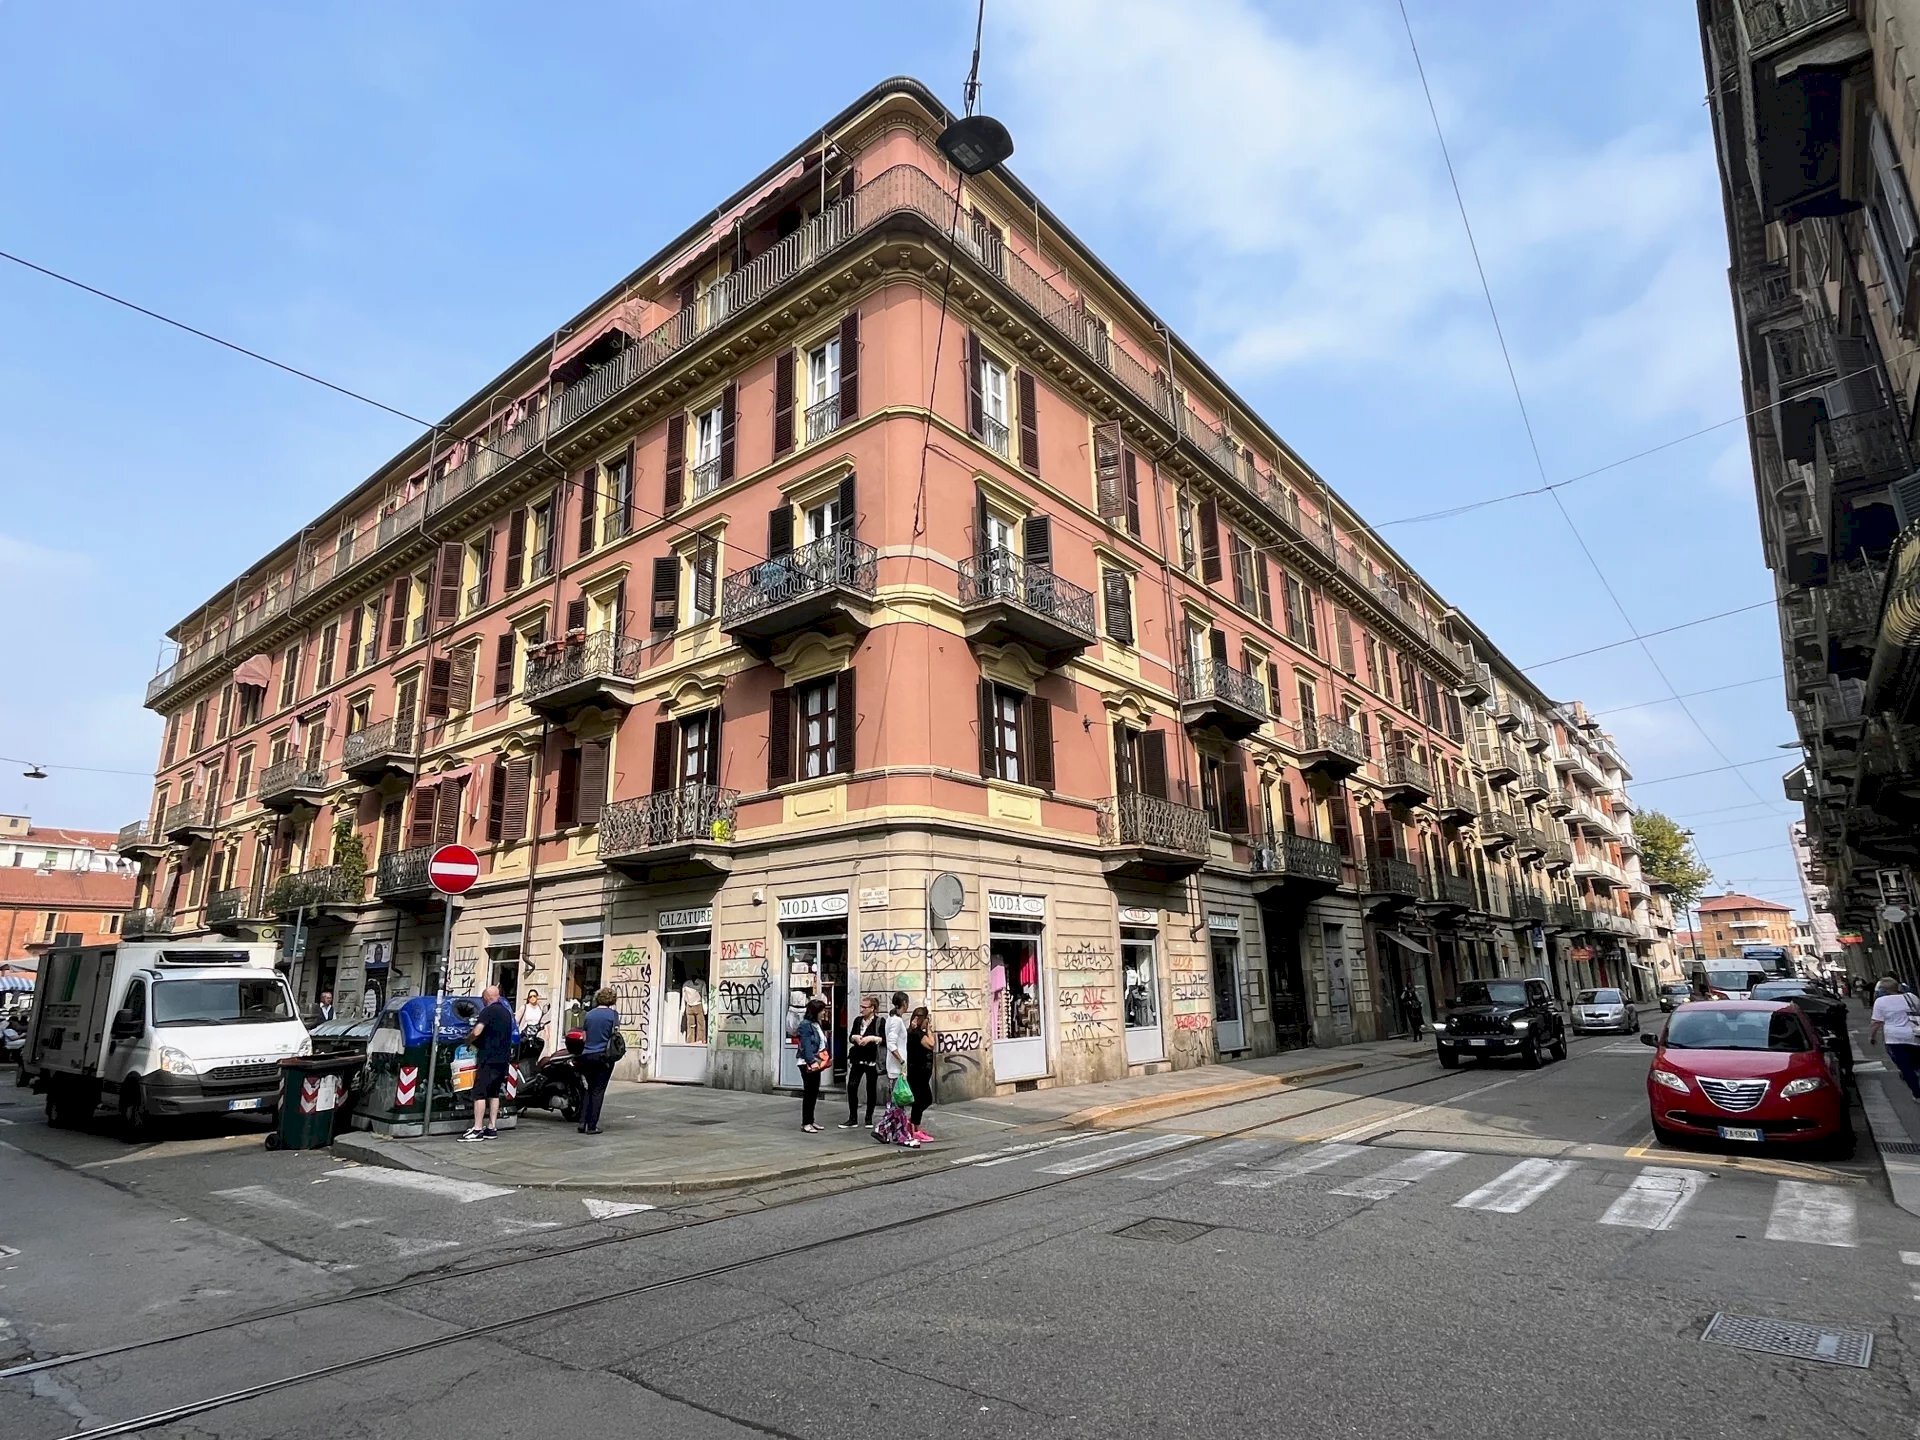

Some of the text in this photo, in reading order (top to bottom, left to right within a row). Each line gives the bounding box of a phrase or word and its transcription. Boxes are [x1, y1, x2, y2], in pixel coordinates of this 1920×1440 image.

[781, 899, 818, 915] MODA
[989, 895, 1020, 910] MODA
[660, 910, 712, 926] CALZATURE
[231, 1057, 266, 1065] IVECO
